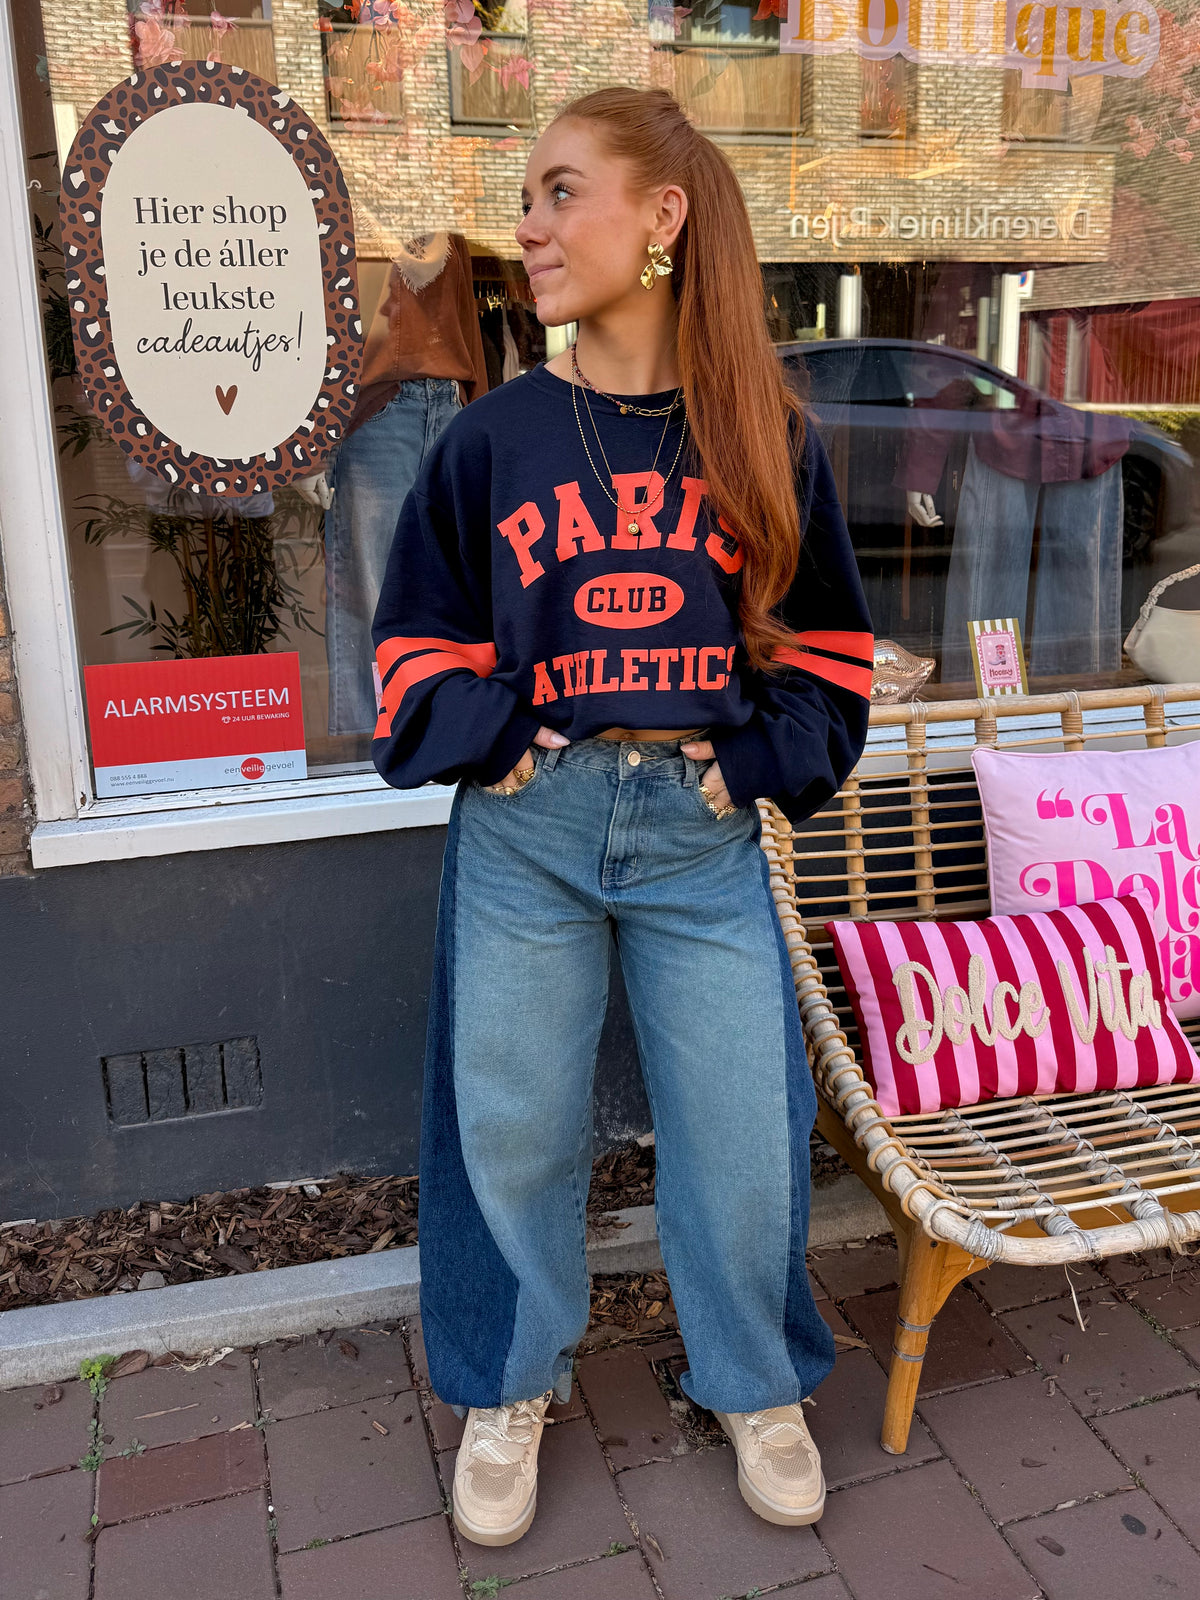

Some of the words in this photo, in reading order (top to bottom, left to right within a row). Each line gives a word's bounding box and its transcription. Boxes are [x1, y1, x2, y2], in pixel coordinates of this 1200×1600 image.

[133, 197, 204, 224] Hier
[212, 196, 287, 232] shop
[137, 241, 167, 276] je
[174, 239, 211, 267] de
[219, 239, 289, 267] áller
[160, 282, 275, 310] leukste
[137, 311, 303, 372] cadeautjes!
[587, 586, 667, 613] CLUB
[104, 687, 290, 719] ALARMSYSTEEM
[241, 714, 255, 722] UUR
[256, 712, 290, 720] BEWAKING
[892, 954, 1050, 1065] Dolce
[1058, 945, 1162, 1045] Vita
